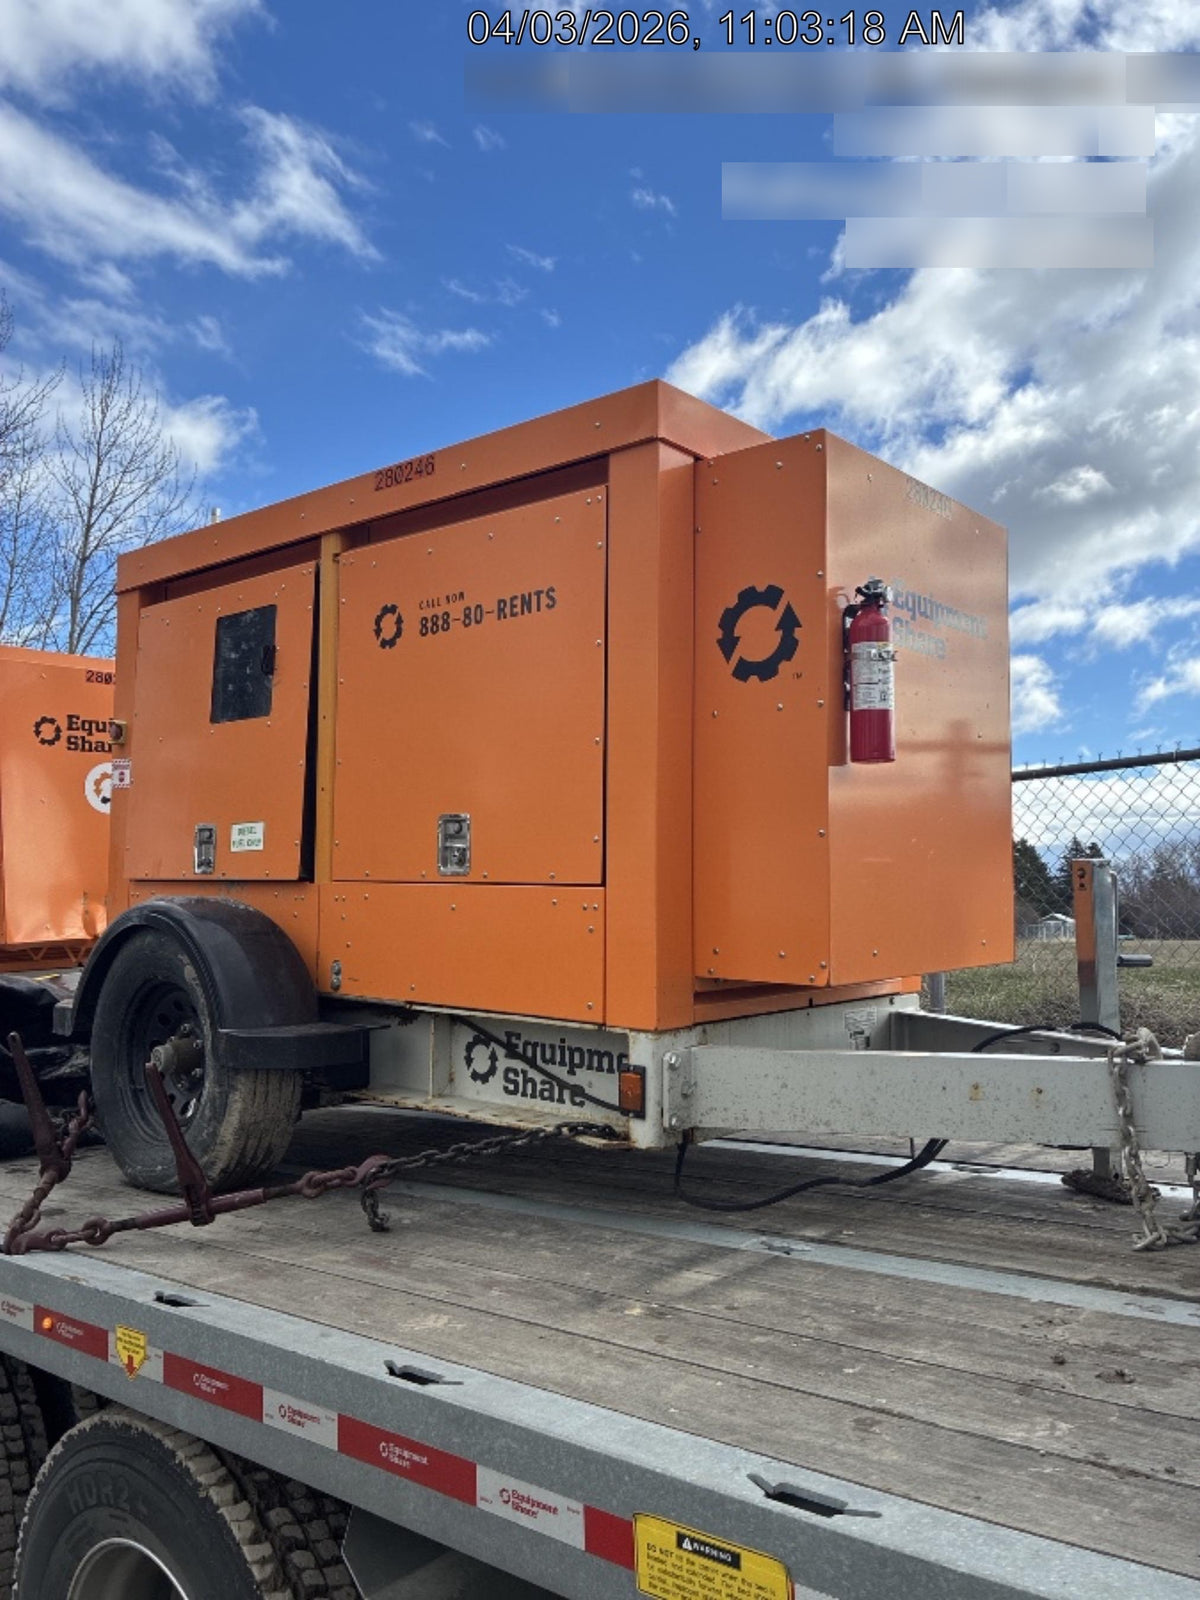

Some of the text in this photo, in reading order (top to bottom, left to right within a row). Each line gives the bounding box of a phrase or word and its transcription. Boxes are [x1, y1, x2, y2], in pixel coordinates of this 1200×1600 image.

[375, 455, 435, 491] 280246
[419, 598, 442, 610] CALL
[419, 586, 557, 637] 888-80-RENTS
[502, 1066, 586, 1108] Share
